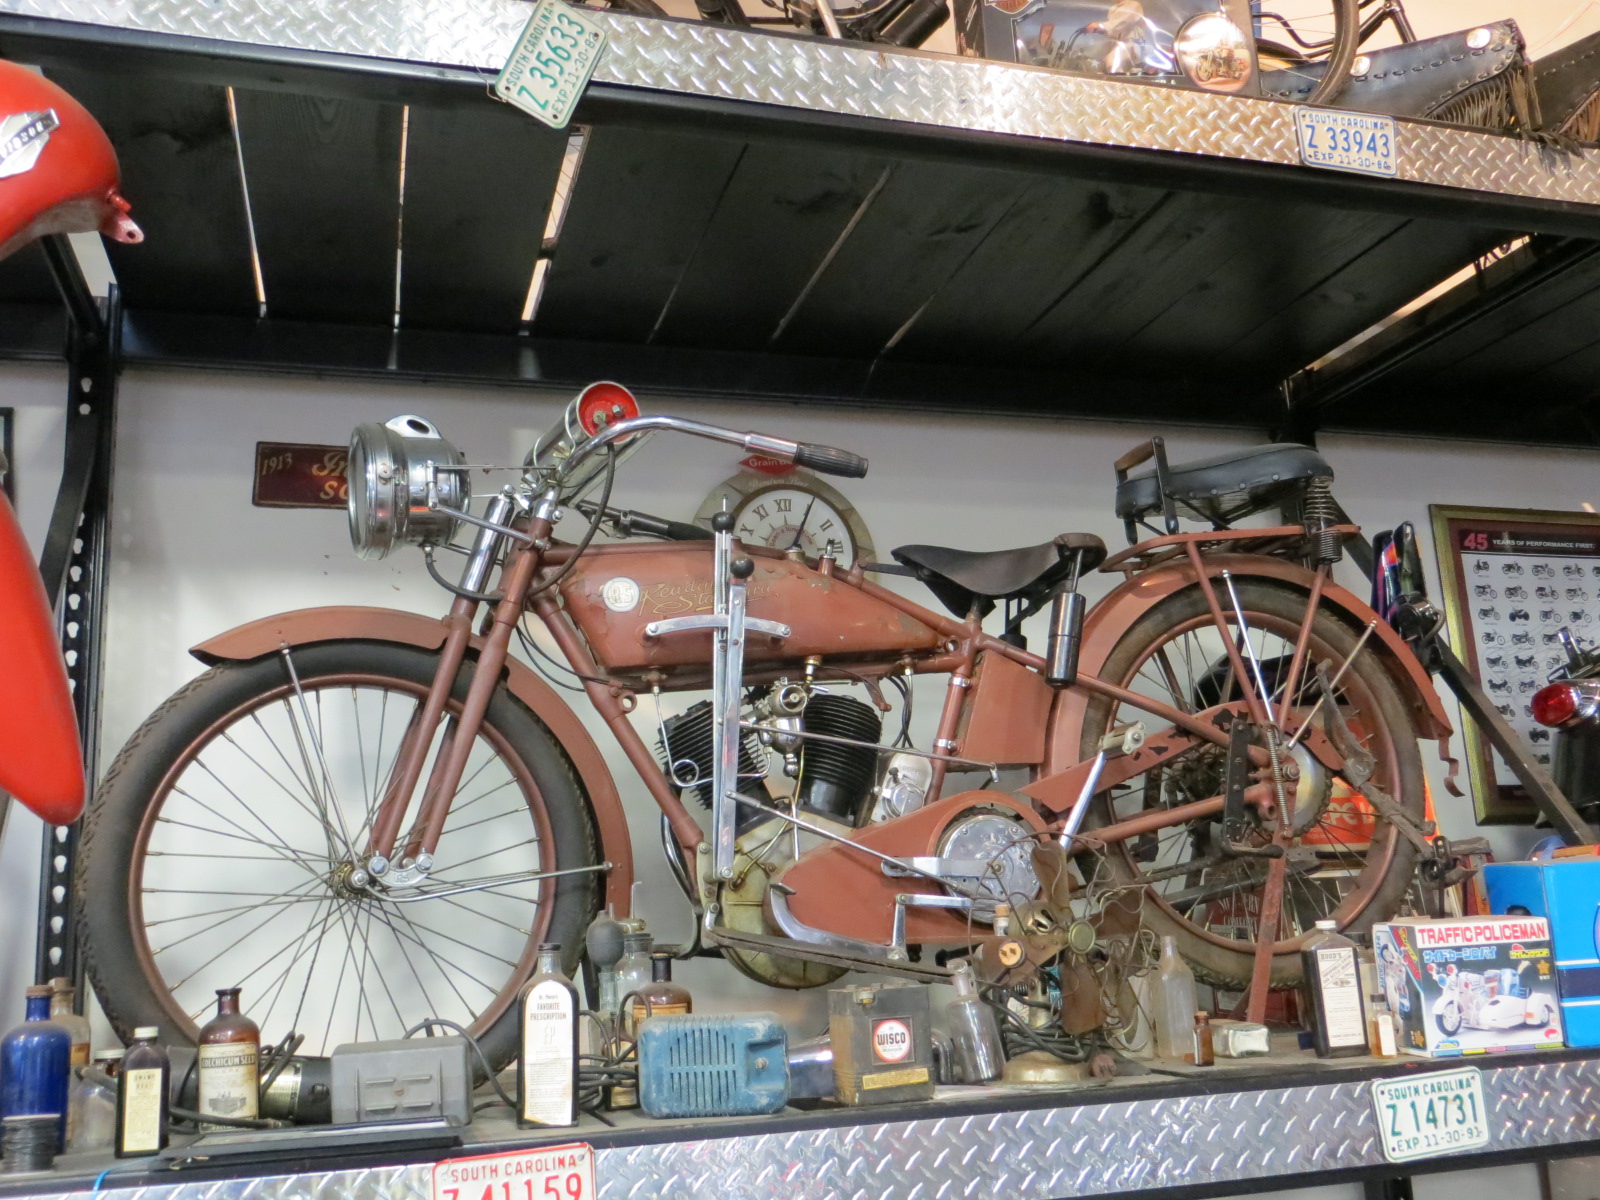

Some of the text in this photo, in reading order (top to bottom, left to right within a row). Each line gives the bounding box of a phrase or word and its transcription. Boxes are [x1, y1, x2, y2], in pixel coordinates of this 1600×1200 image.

[506, 7, 554, 87] SOUTH CAROLINA
[517, 13, 585, 111] Z 35633
[1308, 113, 1385, 130] SOUTH CAROLINA
[1305, 124, 1390, 158] Z 33943
[262, 452, 293, 476] 1913
[749, 457, 778, 467] Grain
[773, 498, 792, 513] XII
[1464, 532, 1488, 550] 45
[1417, 925, 1473, 945] TRAFFIC
[1475, 923, 1546, 943] POLICEMAN
[530, 1012, 567, 1021] PRESCRIPTION
[537, 1002, 560, 1011] FAVORITE
[877, 1032, 906, 1046] WISCO
[201, 1056, 240, 1068] COLCHICUM
[1387, 1078, 1472, 1101] SOUTH CAROLINA
[1386, 1092, 1478, 1137] Z 14731
[451, 1154, 577, 1183] SOUTH CAROLINA
